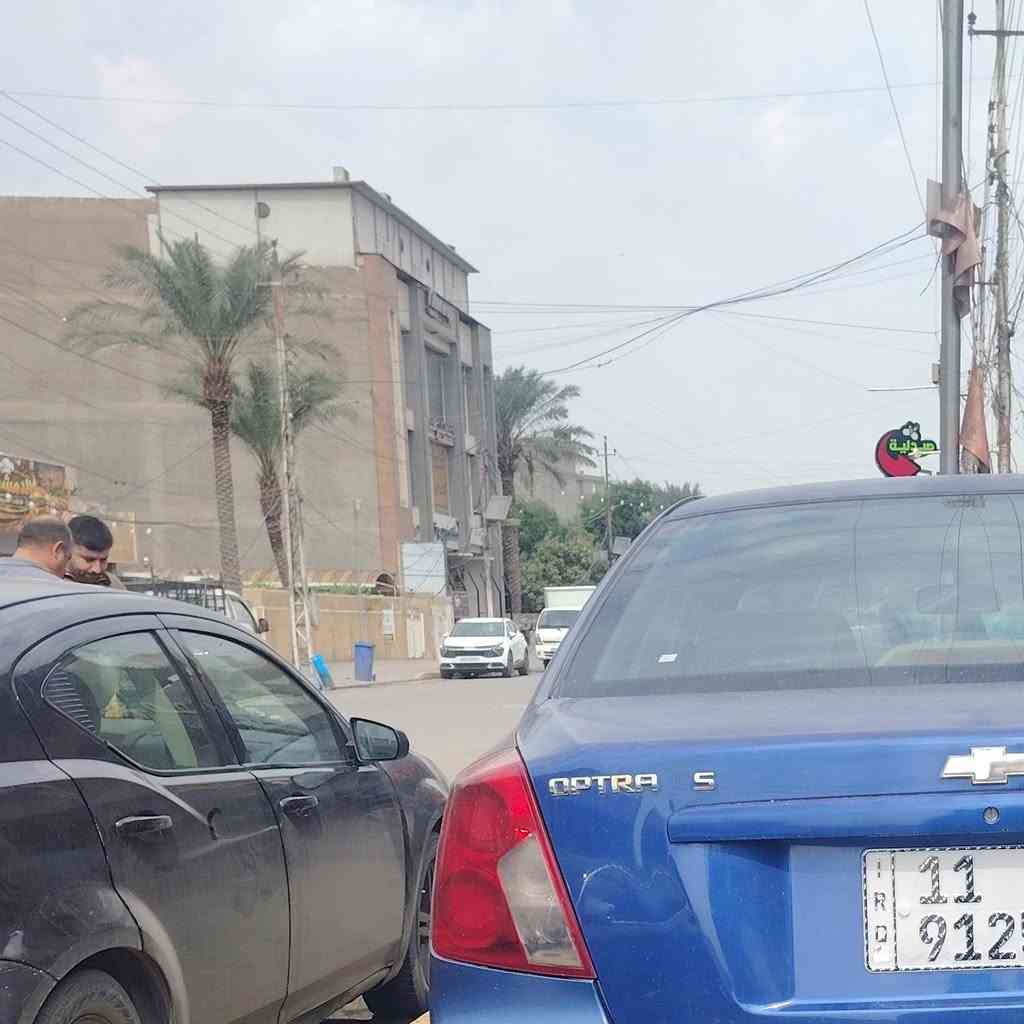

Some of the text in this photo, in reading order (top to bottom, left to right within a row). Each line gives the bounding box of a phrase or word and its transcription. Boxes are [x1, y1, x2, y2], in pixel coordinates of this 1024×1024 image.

[548, 772, 715, 797] OPTRA S
[919, 855, 982, 905] 11
